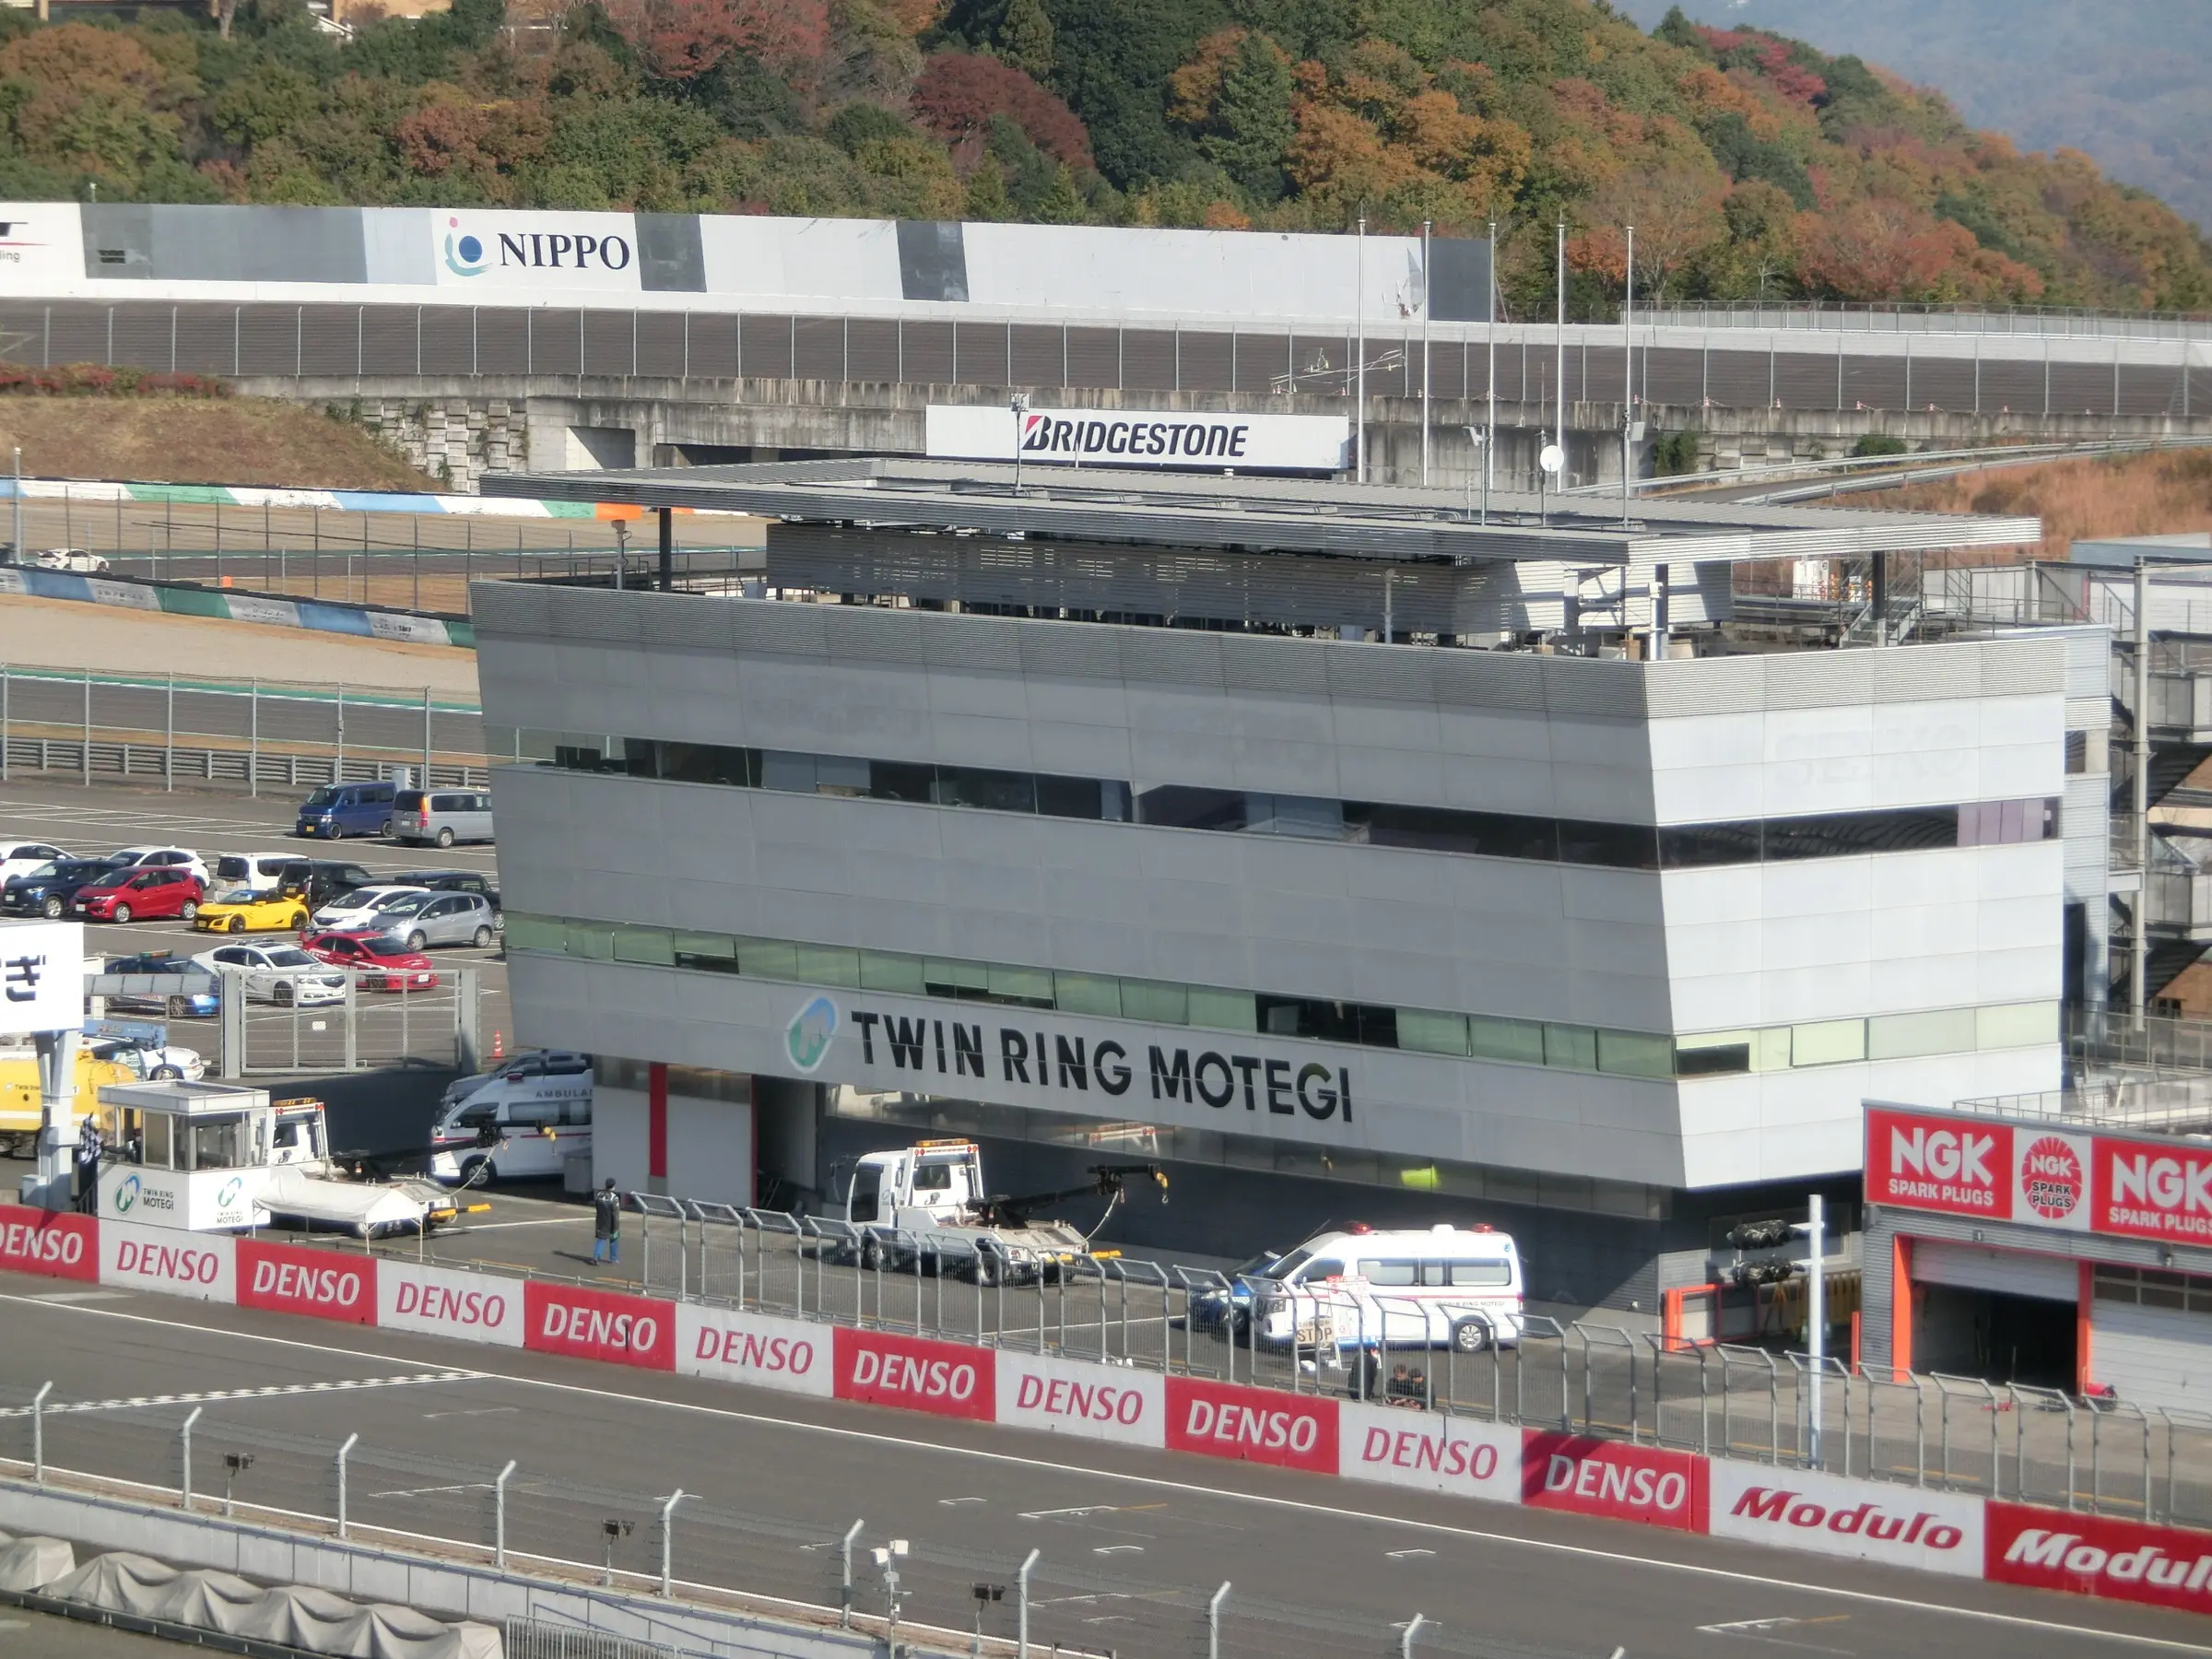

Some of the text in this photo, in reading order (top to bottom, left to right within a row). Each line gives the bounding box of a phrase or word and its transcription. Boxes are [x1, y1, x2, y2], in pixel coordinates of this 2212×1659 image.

[498, 232, 630, 270] NIPPO
[1021, 415, 1249, 457] BRIDGESTONE
[0, 954, 46, 1002] ぎ
[851, 1011, 1353, 1123] TWIN RING MOTEGI
[1890, 1125, 1994, 1187] NGK
[2030, 1154, 2072, 1178] NGK
[143, 1196, 174, 1210] MOTEGI
[144, 1188, 174, 1198] TWIN RING
[1888, 1178, 1994, 1206] SPARK PLUGS
[2032, 1182, 2071, 1195] SPARK
[2032, 1194, 2072, 1207] PLUGS
[2112, 1151, 2212, 1212] NGK
[217, 1216, 243, 1224] MOTEGI
[2109, 1206, 2161, 1229] SPARK
[0, 1222, 84, 1265] ENSO
[117, 1241, 219, 1285] DENSO
[253, 1260, 360, 1306] DENSO
[396, 1281, 505, 1327] DENSO
[542, 1302, 657, 1352] DENSO
[695, 1326, 814, 1375] DENSO
[852, 1349, 976, 1400] DENSO
[1016, 1374, 1144, 1425] DENSO
[1185, 1399, 1318, 1453] DENSO
[1362, 1427, 1499, 1480] DENSO
[1544, 1453, 1688, 1512] DENSO
[1729, 1486, 1964, 1549] Modulo
[2004, 1528, 2212, 1593] Modul
